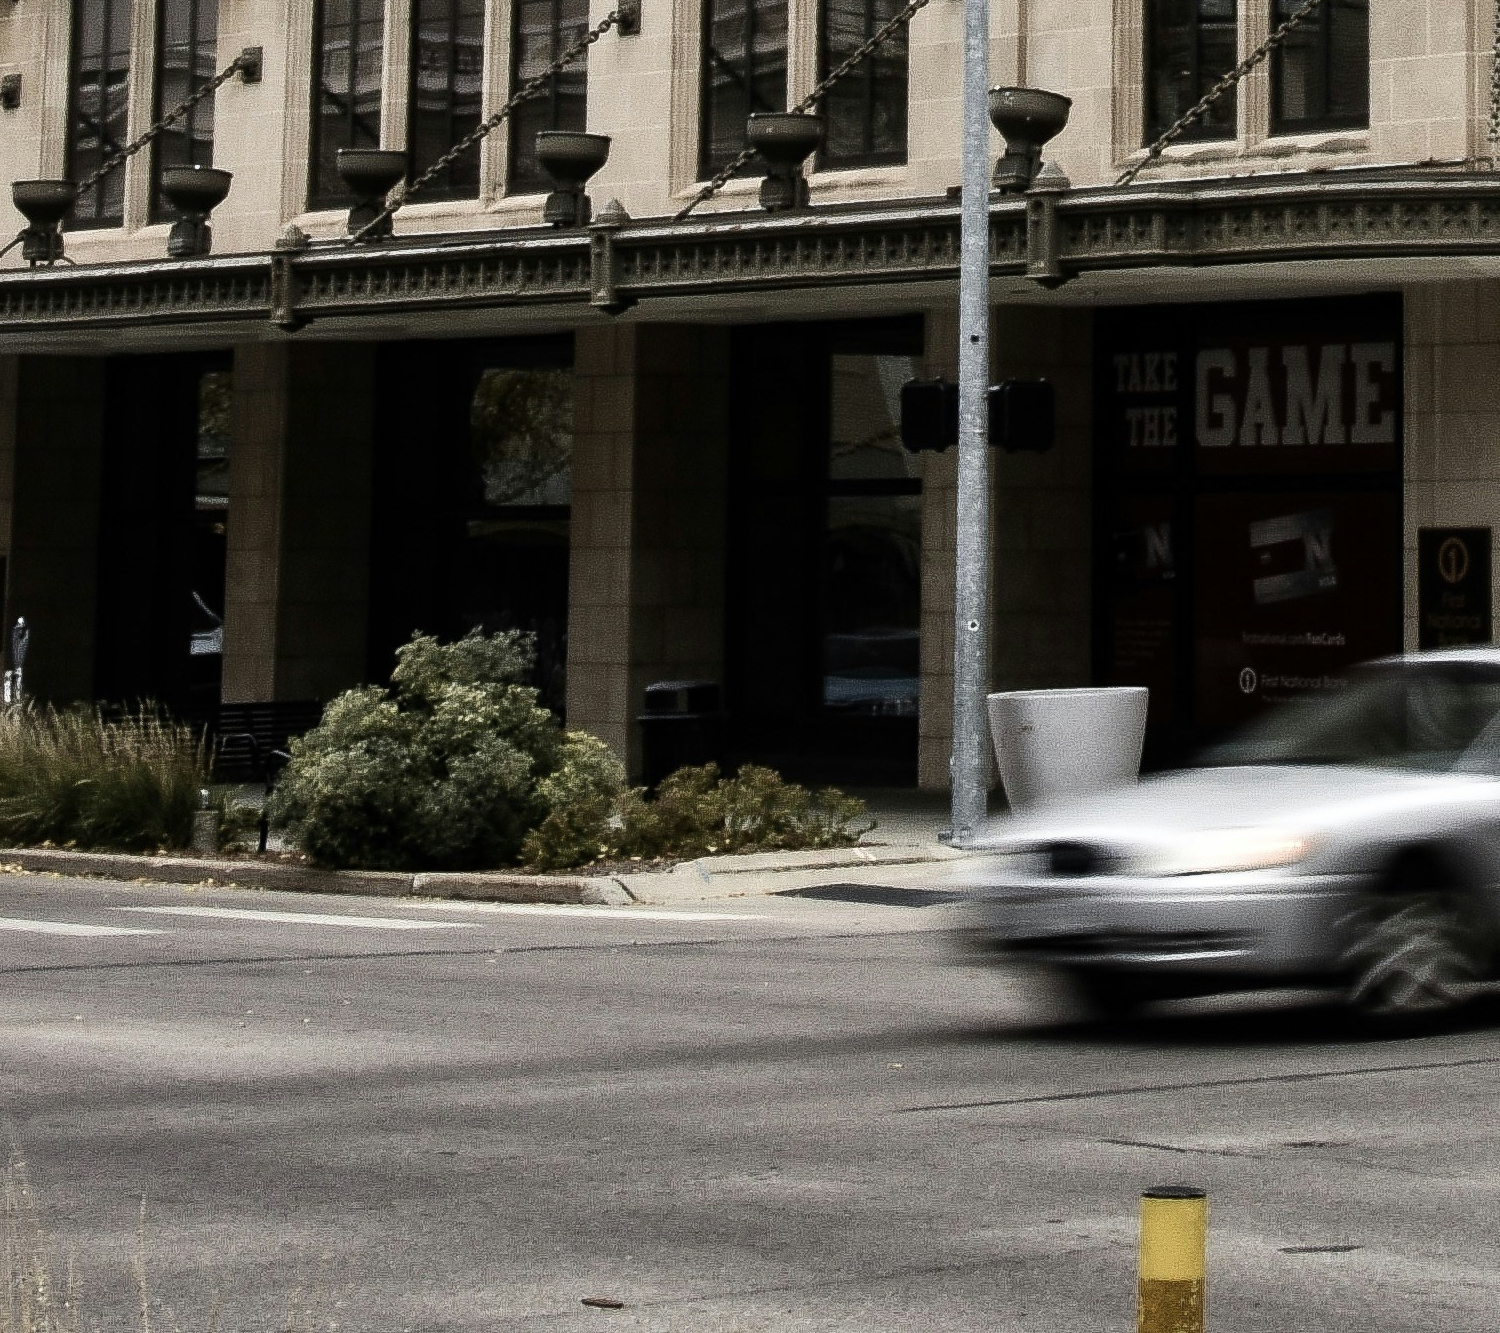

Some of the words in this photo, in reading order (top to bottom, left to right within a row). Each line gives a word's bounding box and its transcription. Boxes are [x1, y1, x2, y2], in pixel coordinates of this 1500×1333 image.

[1112, 351, 1179, 393] TAKE
[1195, 343, 1396, 447] GAME
[1124, 406, 1179, 448] THE
